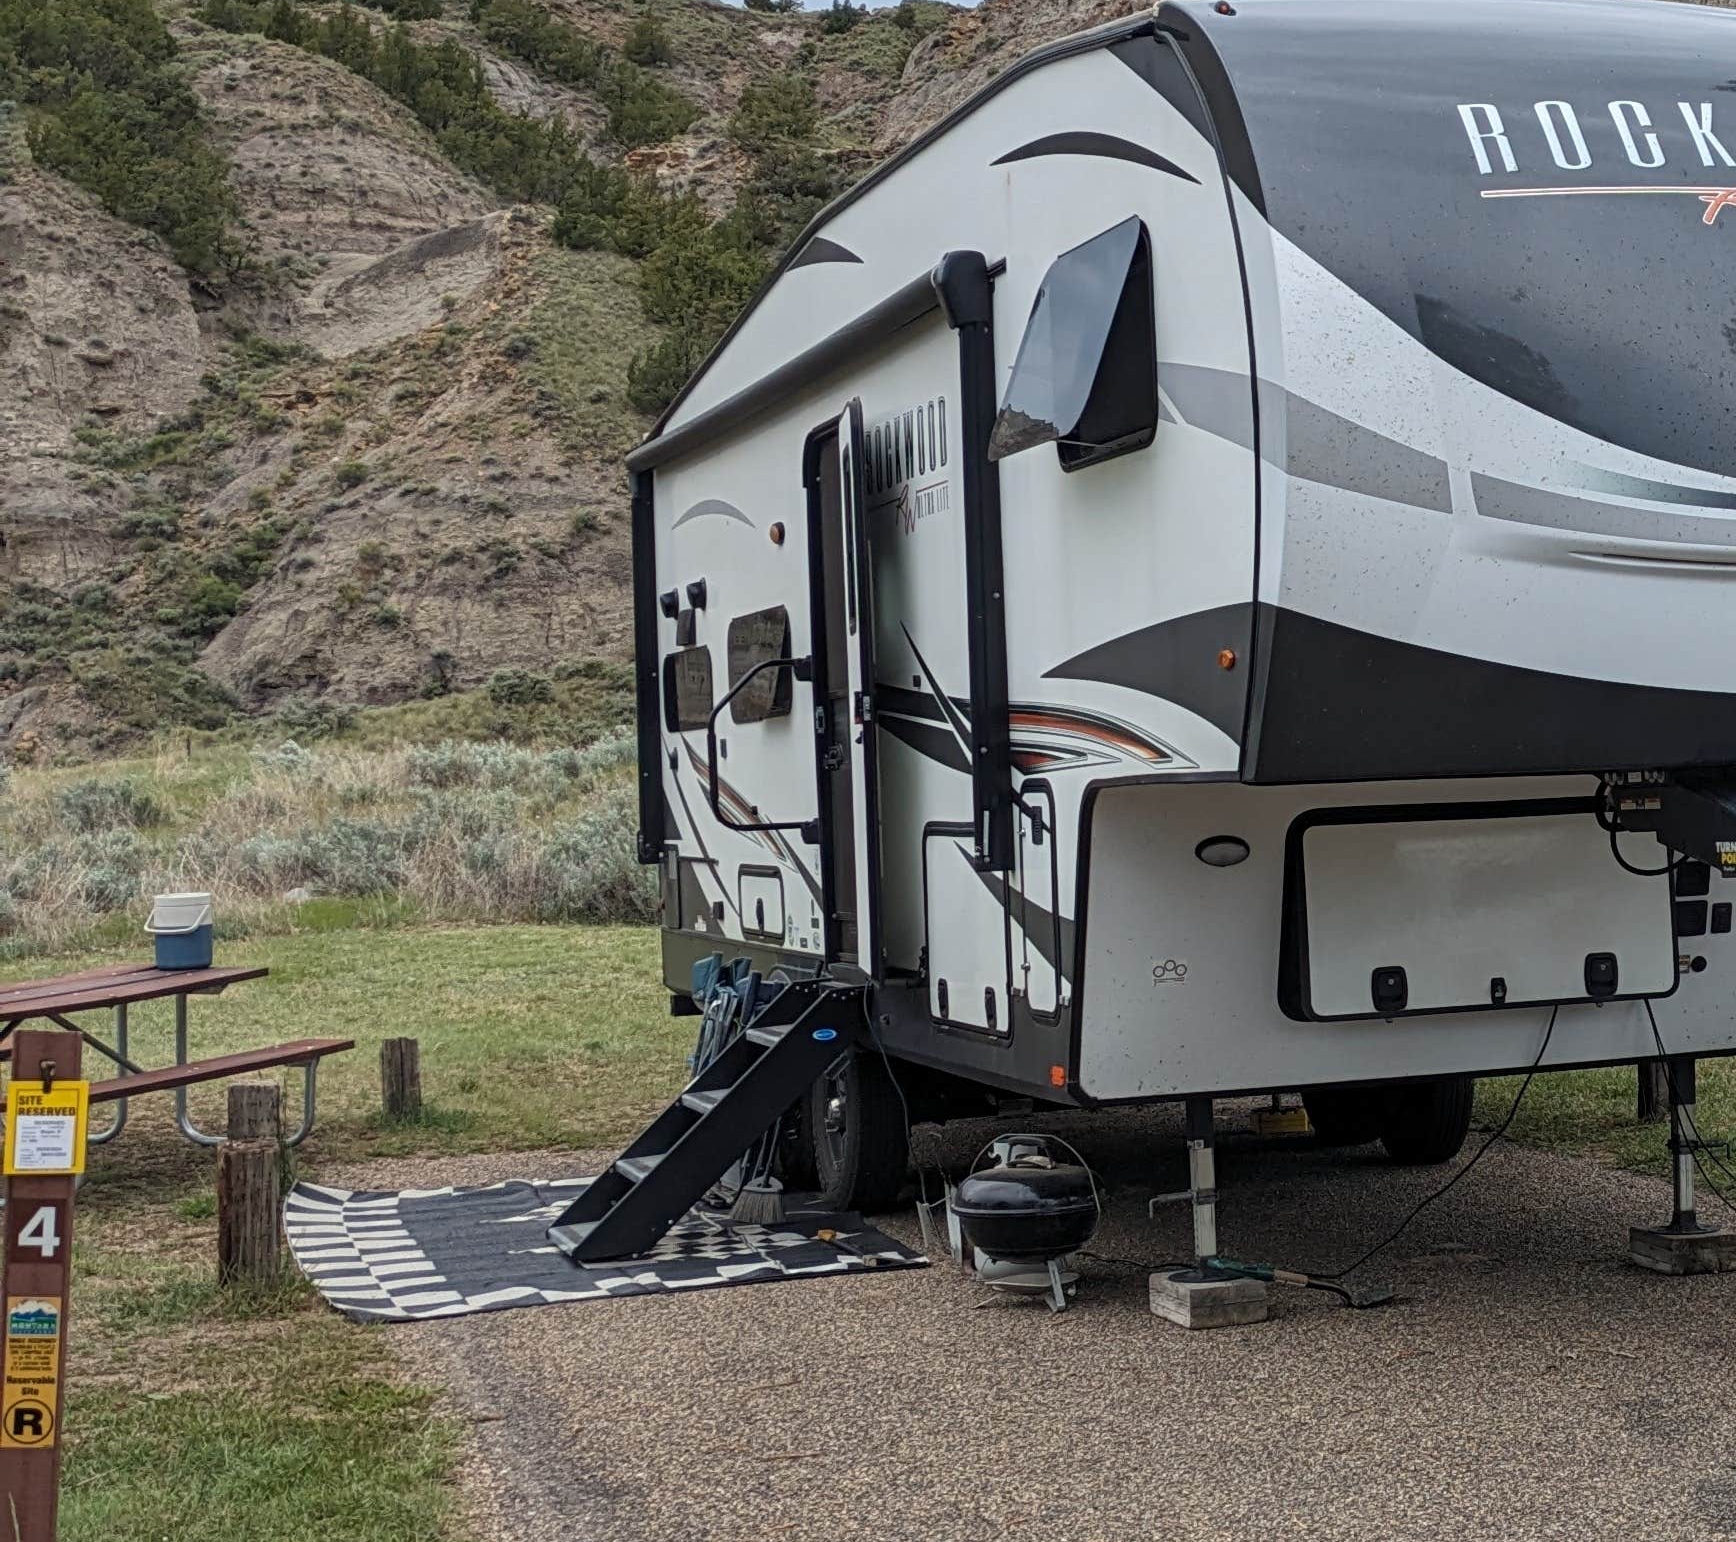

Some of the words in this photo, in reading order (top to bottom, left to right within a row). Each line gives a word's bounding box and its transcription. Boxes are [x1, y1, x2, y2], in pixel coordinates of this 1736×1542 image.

[864, 395, 948, 496] ROCKWOOD
[18, 1095, 43, 1106] SITE
[18, 1106, 76, 1116] RESERVED
[17, 1206, 61, 1257] 4
[6, 1375, 56, 1385] Reservable
[21, 1386, 39, 1395] Site
[13, 1407, 43, 1436] R
